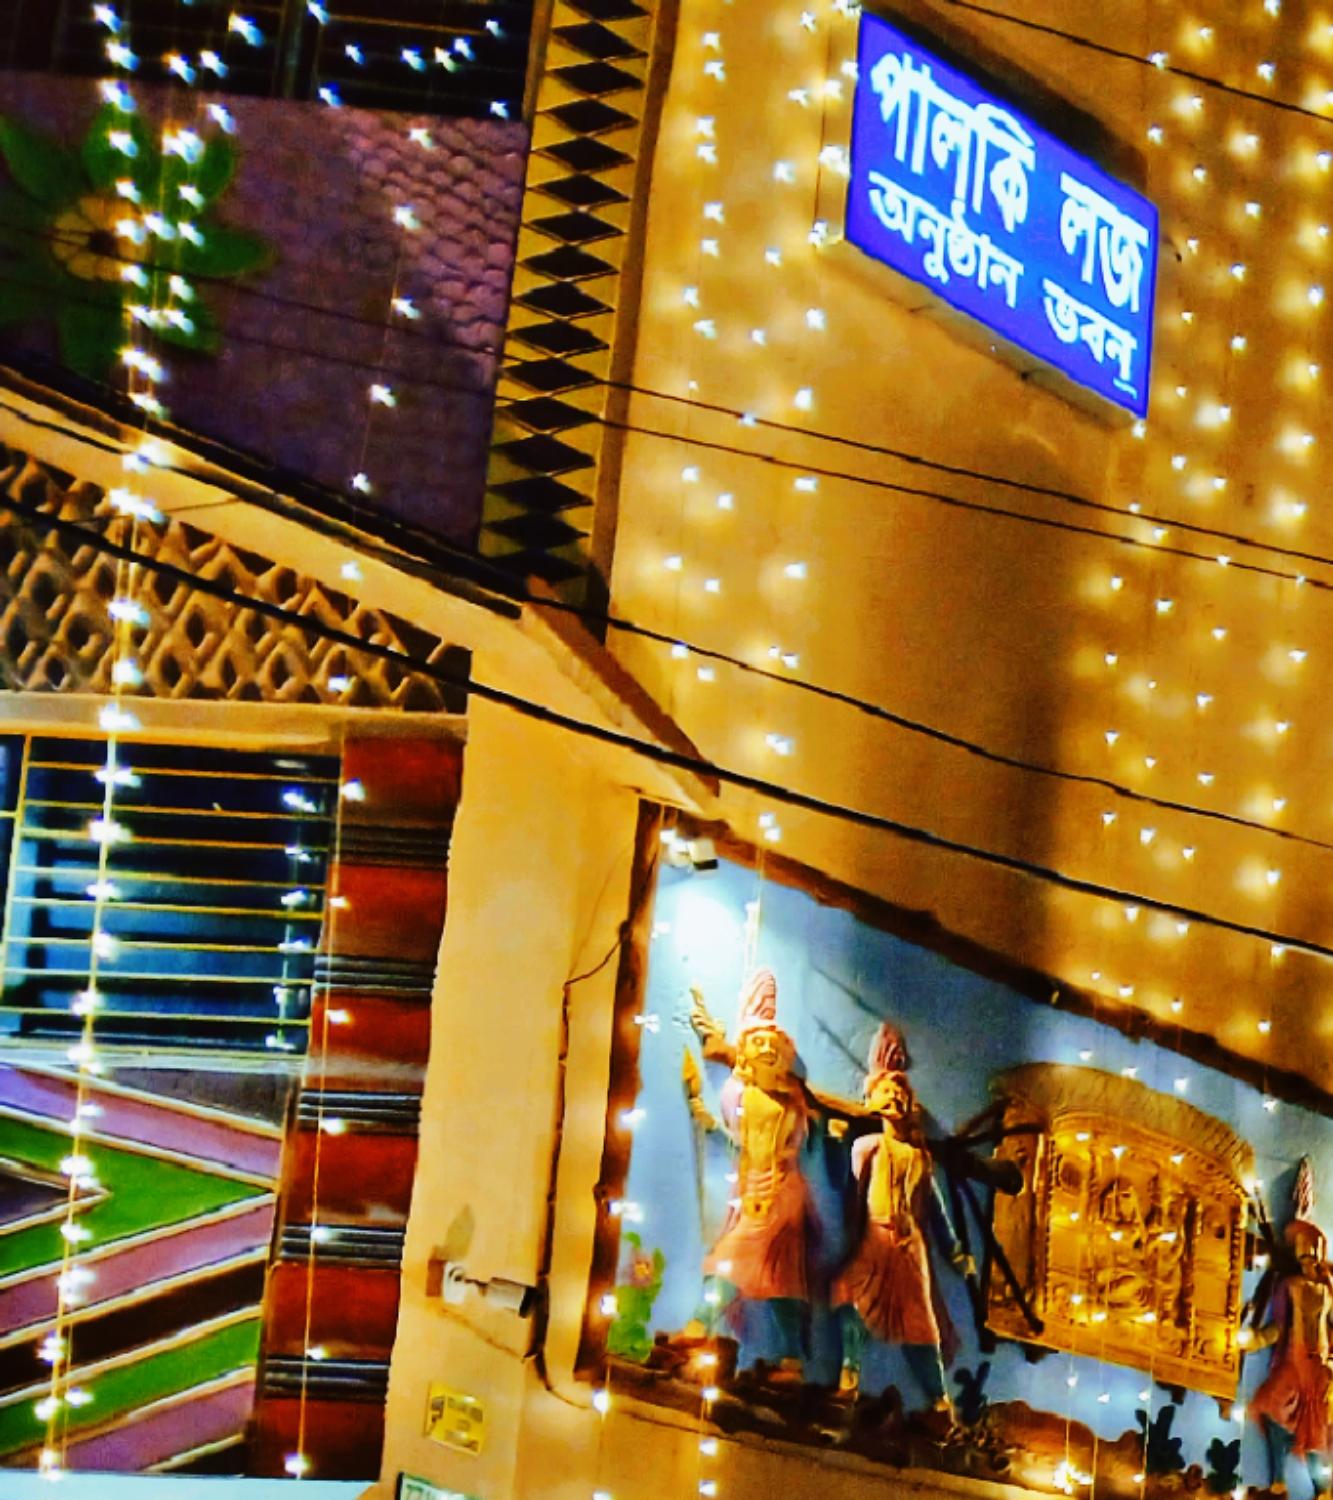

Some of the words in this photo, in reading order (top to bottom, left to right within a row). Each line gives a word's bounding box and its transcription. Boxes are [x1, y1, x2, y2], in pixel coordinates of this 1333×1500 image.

[868, 170, 1025, 308] অনুষ্ঠান
[869, 51, 1036, 233] পালকি
[1059, 171, 1149, 313] লজ
